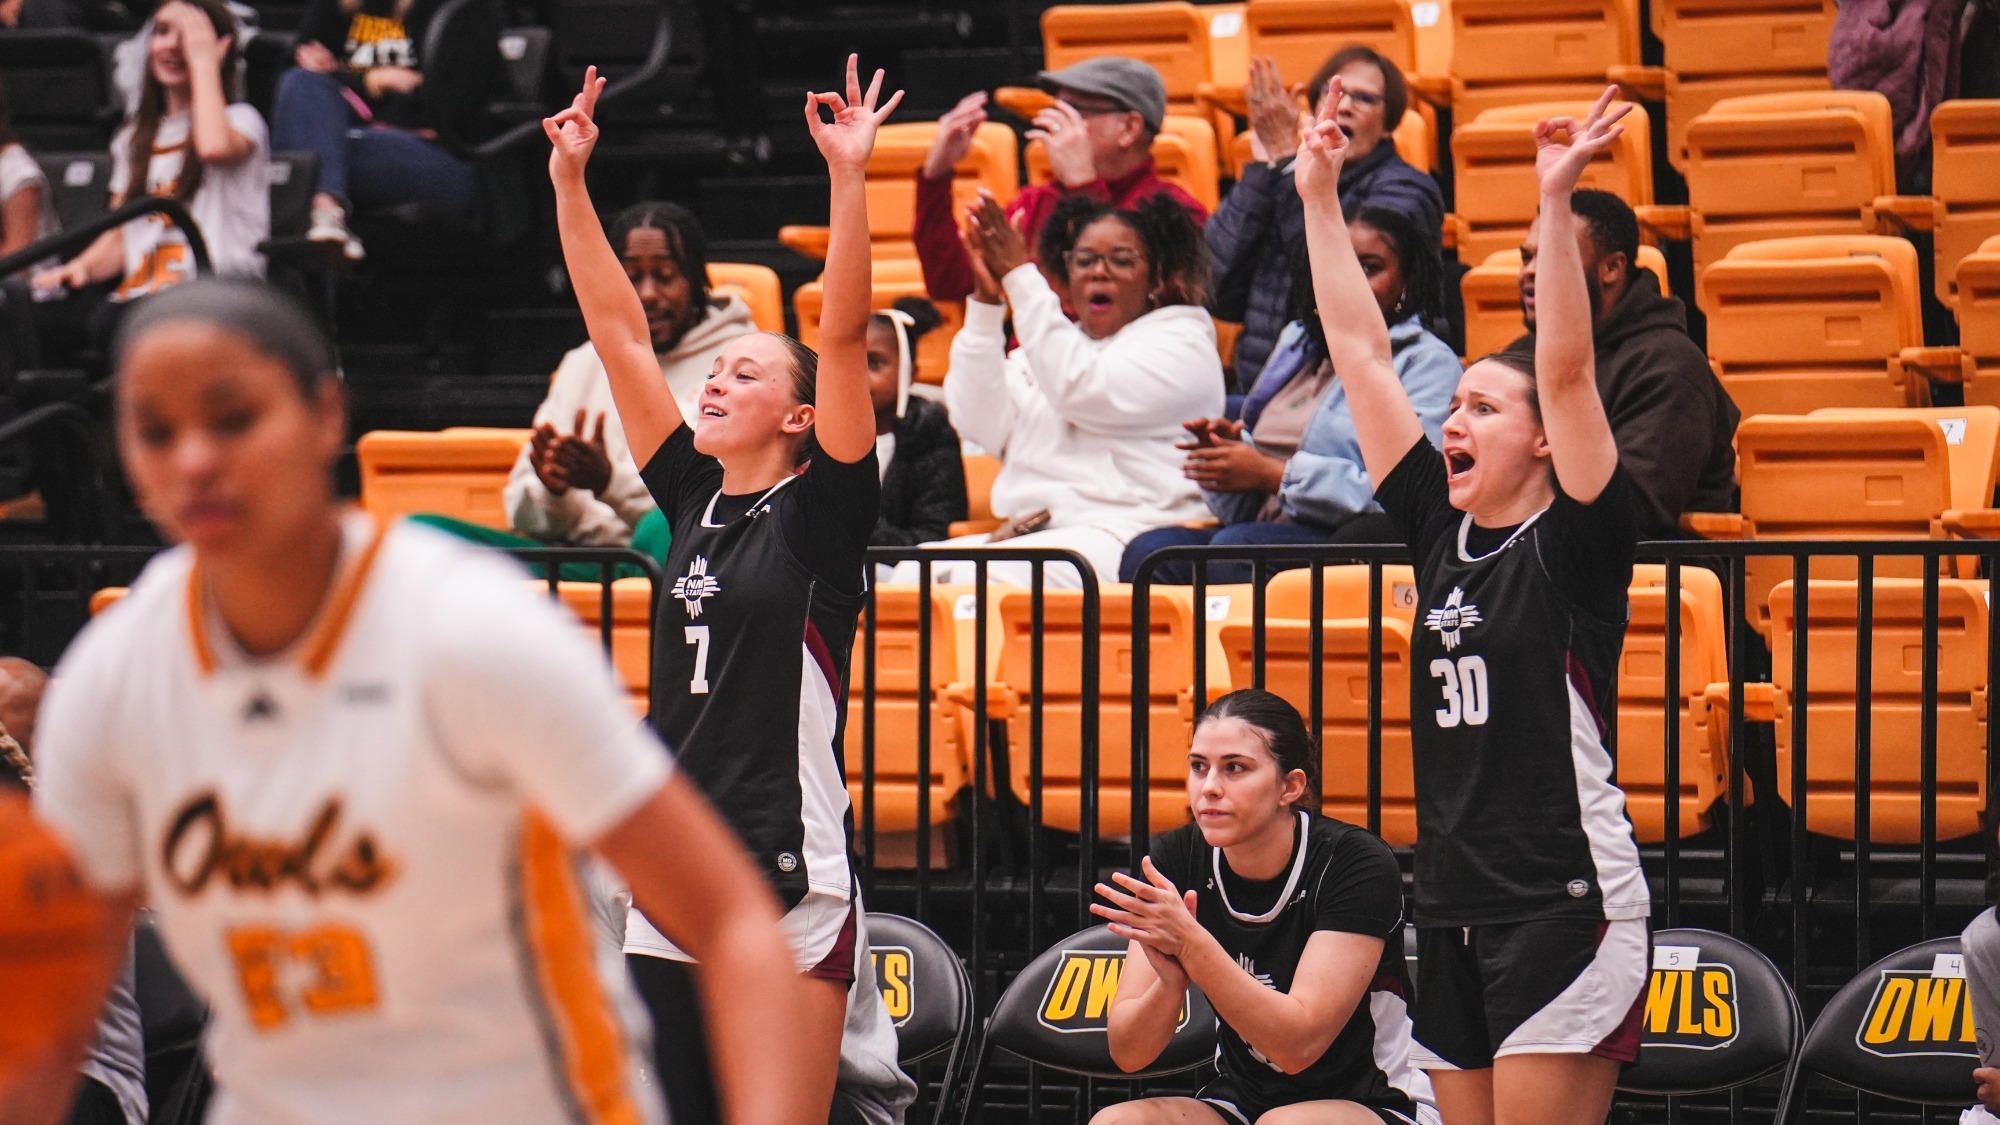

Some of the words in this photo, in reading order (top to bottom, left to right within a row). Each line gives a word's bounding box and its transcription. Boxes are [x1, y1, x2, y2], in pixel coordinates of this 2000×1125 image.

[686, 579, 704, 589] NM
[1404, 588, 1413, 605] 6
[1442, 608, 1459, 620] NM
[684, 625, 710, 694] 7
[1429, 655, 1489, 729] 30
[1669, 952, 1680, 966] 5
[1951, 960, 1961, 974] 4
[1044, 957, 1126, 1020] OW
[1642, 970, 1732, 1038] WLS
[1863, 977, 1977, 1044] OWL
